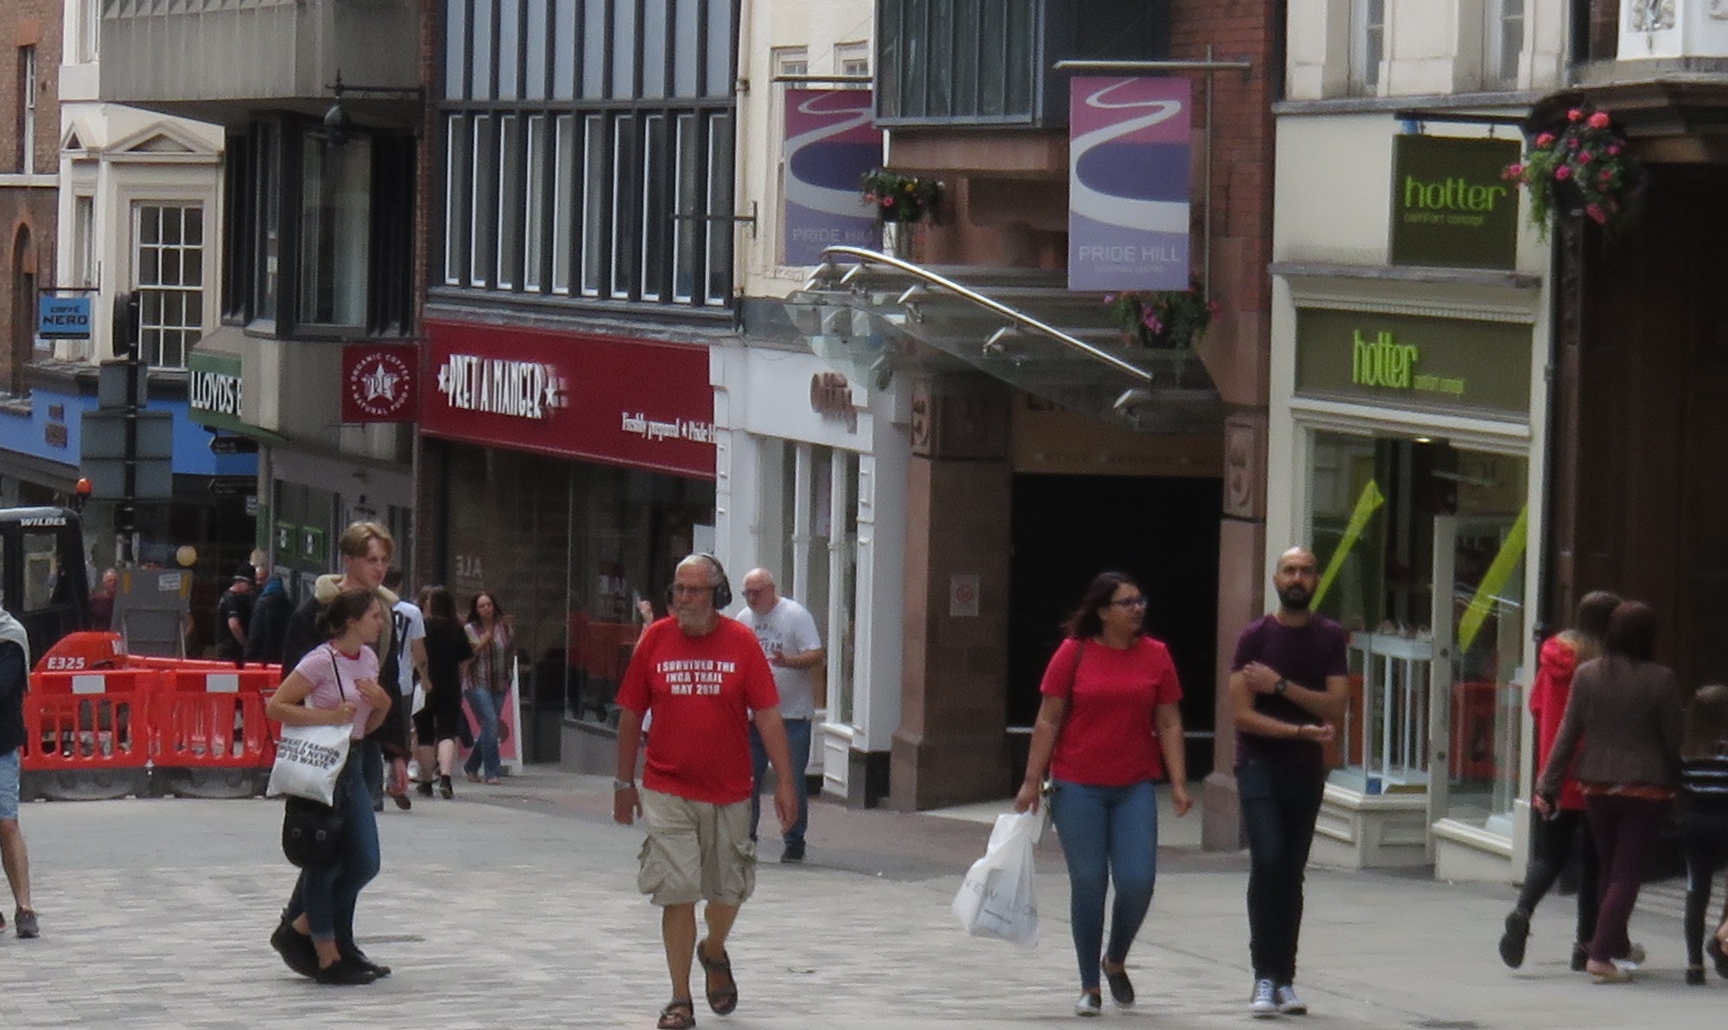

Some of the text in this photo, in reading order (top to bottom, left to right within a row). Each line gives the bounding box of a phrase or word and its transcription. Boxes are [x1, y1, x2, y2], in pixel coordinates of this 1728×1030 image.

[1404, 175, 1507, 211] hotter
[1078, 245, 1181, 263] PRIDE HILL
[42, 315, 88, 326] NERO
[1353, 329, 1419, 388] hotter
[190, 371, 235, 415] LLOYDS
[448, 353, 544, 420] PRET A MANGER
[47, 657, 85, 670] E325
[662, 659, 714, 672] SURVIVED
[716, 660, 736, 673] THE
[666, 672, 723, 683] INCA TRAIL
[671, 684, 693, 695] MAY
[279, 737, 302, 747] REAT
